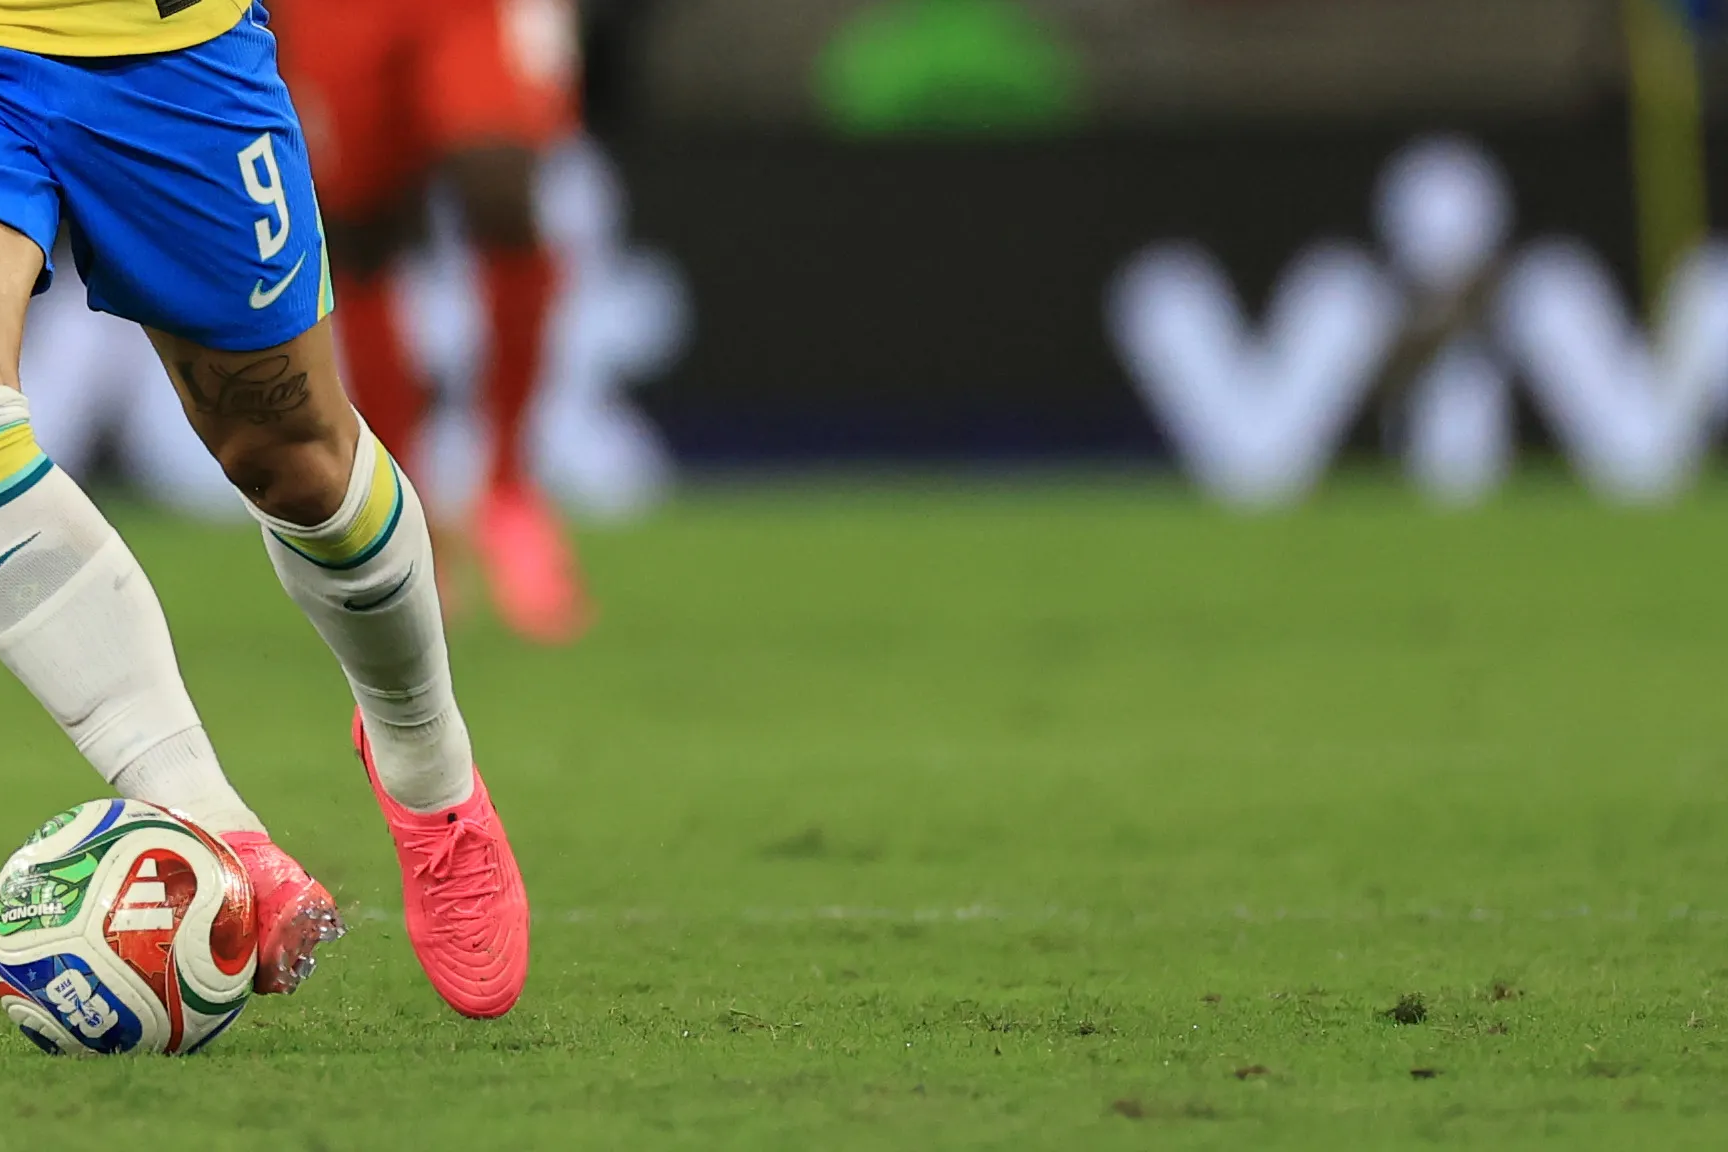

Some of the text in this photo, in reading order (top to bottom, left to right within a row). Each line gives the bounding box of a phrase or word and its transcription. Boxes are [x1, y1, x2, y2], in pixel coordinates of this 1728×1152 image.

[236, 131, 290, 262] 9
[1, 901, 67, 924] TRIONDA
[54, 978, 72, 993] FIFA
